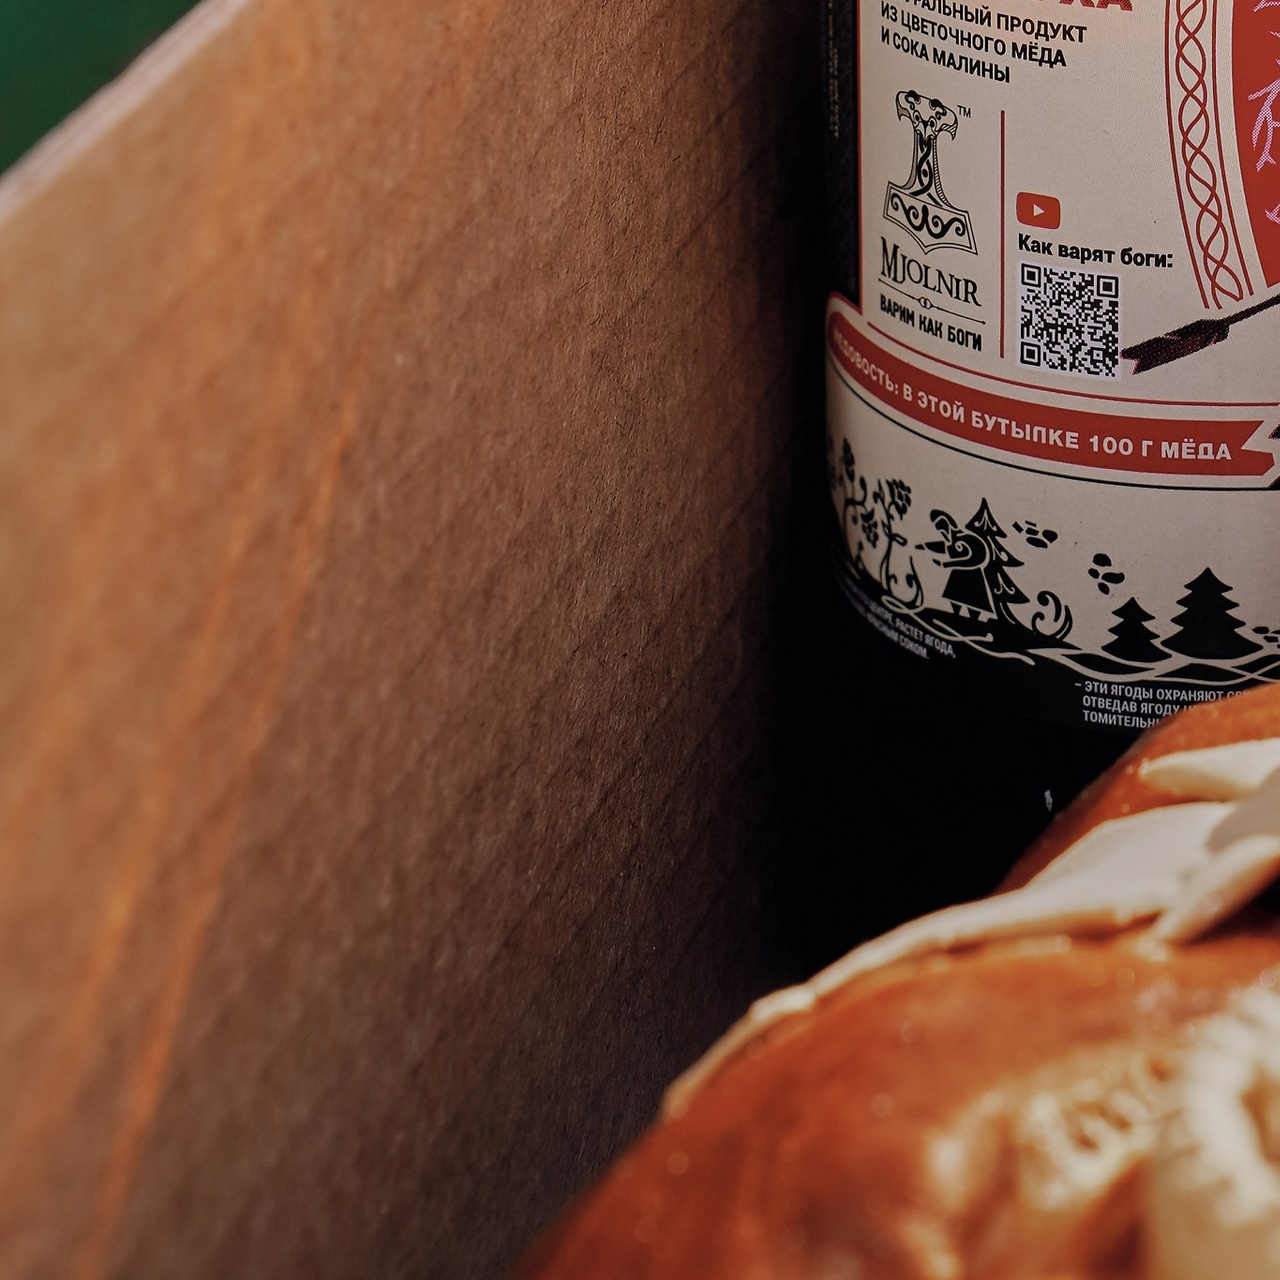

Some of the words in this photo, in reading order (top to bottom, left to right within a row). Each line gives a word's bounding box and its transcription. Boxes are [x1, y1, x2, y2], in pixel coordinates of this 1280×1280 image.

[880, 1, 898, 23] ИЗ
[901, 8, 1006, 56] ЦВЕТОЧНОГО
[1011, 41, 1067, 68] МЁДА
[881, 26, 890, 45] И
[892, 31, 929, 62] СОКА
[932, 46, 1010, 83] МАЛИНЫ
[996, 13, 1087, 43] ПРОДУКТ
[880, 236, 982, 306] MJOLNIR
[1018, 233, 1053, 256] Как
[1058, 241, 1115, 267] варят
[1120, 247, 1173, 269] боги:
[880, 293, 915, 329] ВАРИМ
[919, 311, 943, 340] КАК
[947, 321, 982, 352] БОГИ
[903, 384, 913, 402] В
[918, 392, 965, 423] ЭТОЙ
[971, 410, 1080, 449] БУТЫЛКЕ
[1089, 435, 1134, 458] 100
[1142, 439, 1153, 459] Г
[1160, 437, 1232, 460] МЁДА
[1083, 695, 1137, 714] ОТВЕДАВ
[1140, 703, 1180, 717] ЯГОДУ
[1084, 681, 1108, 694] ЭТИ
[1111, 684, 1153, 700] ЯГОДЫ
[1156, 688, 1224, 702] ОХРАНЯЮТ
